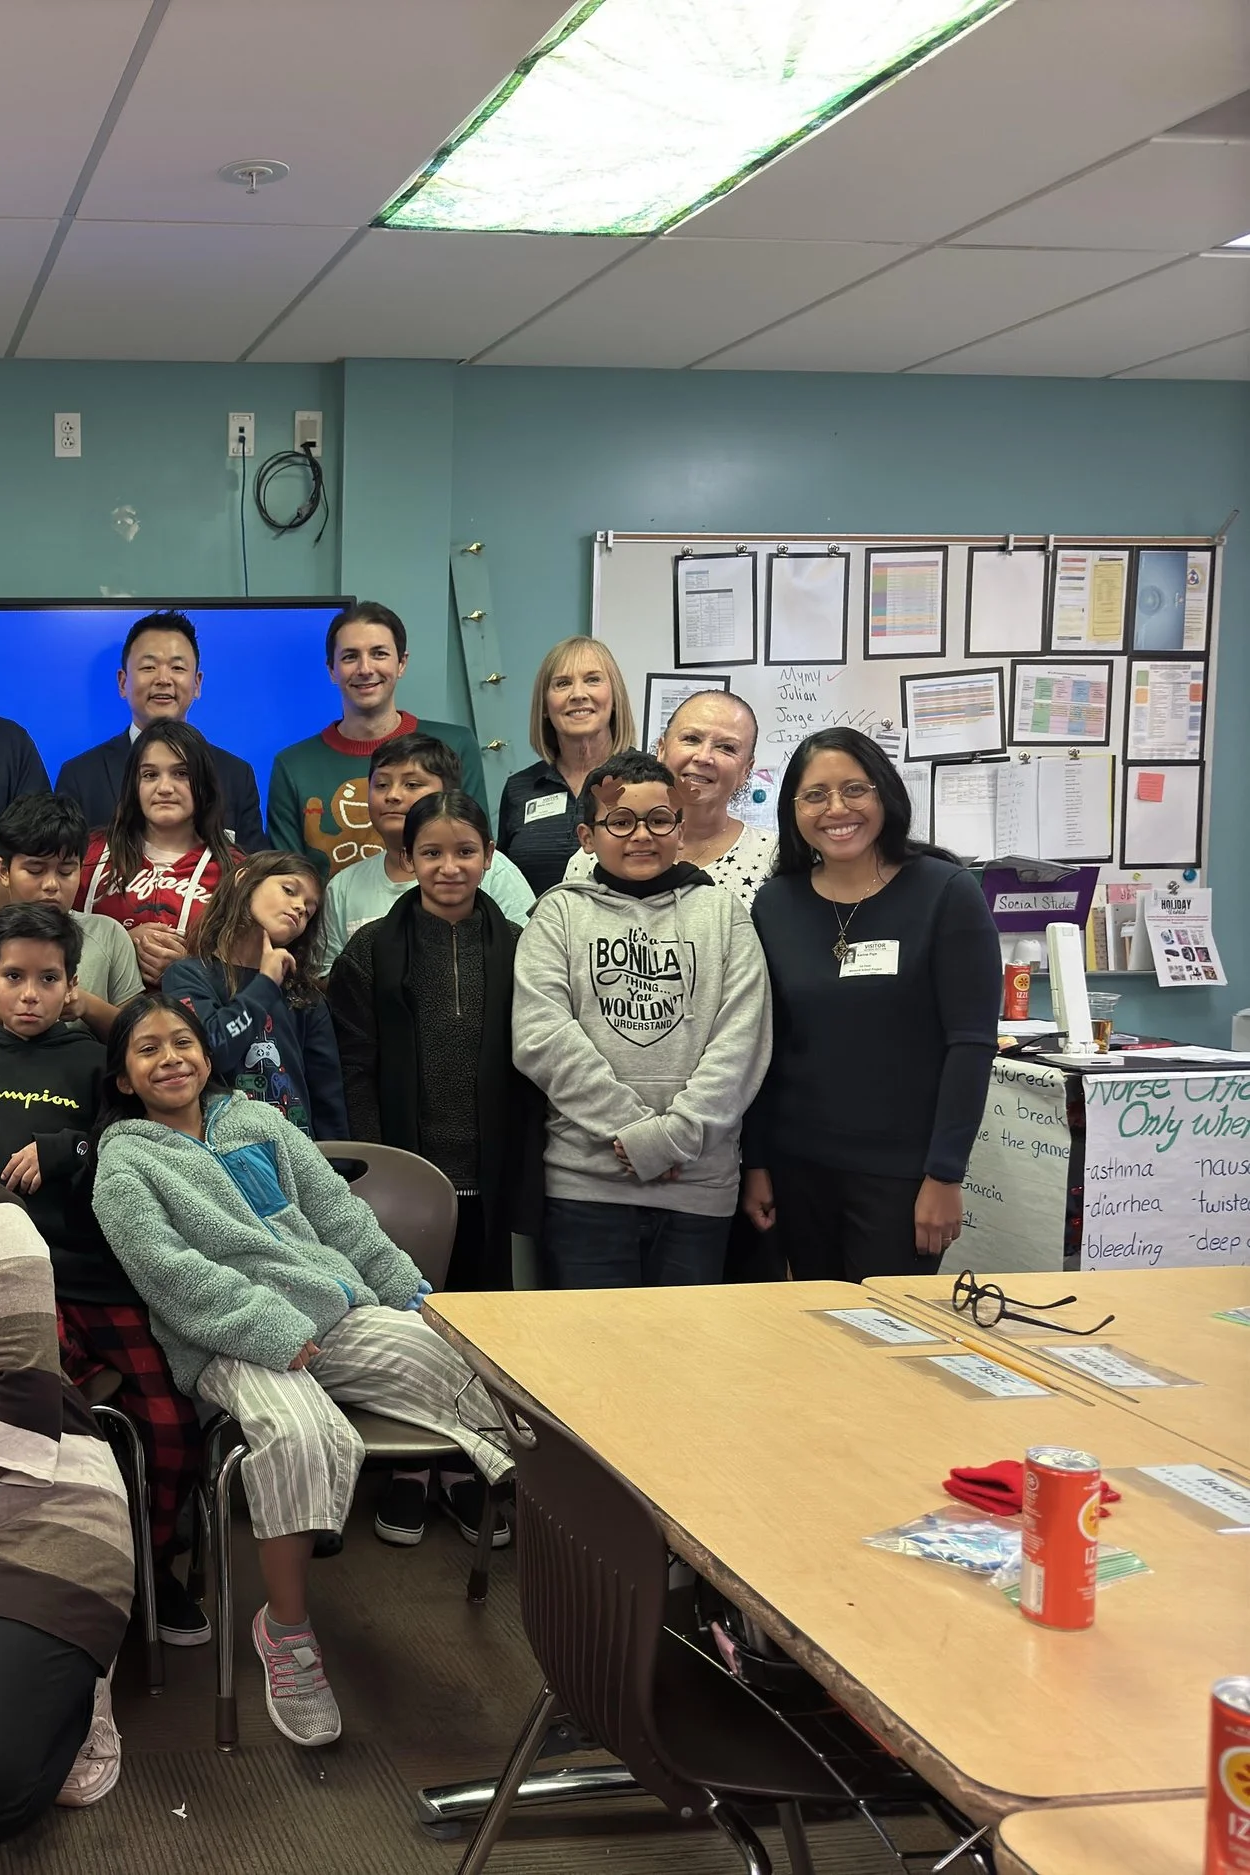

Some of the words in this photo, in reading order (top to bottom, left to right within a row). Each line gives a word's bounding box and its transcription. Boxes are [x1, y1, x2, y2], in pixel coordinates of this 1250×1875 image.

[777, 684, 817, 702] Julian
[775, 706, 815, 729] Jorge
[998, 895, 1038, 910] Social
[1161, 899, 1192, 910] HOLIDAY
[629, 927, 648, 943] It's
[596, 937, 681, 976] BONILLA
[598, 993, 684, 1022] WOULDN'T
[627, 987, 654, 1002] You
[991, 1063, 1056, 1089] njured:
[1086, 1078, 1171, 1106] Nurse
[1184, 1075, 1250, 1103] Offic
[993, 1103, 1006, 1117] a
[1016, 1097, 1068, 1128] break
[1118, 1100, 1184, 1153] Only
[1001, 1128, 1026, 1150] the
[1030, 1140, 1070, 1159] game
[960, 1174, 1004, 1203] Garcia
[1196, 1478, 1250, 1507] Isaia
[1085, 1546, 1097, 1565] IZ
[1228, 1811, 1250, 1842] IZ
